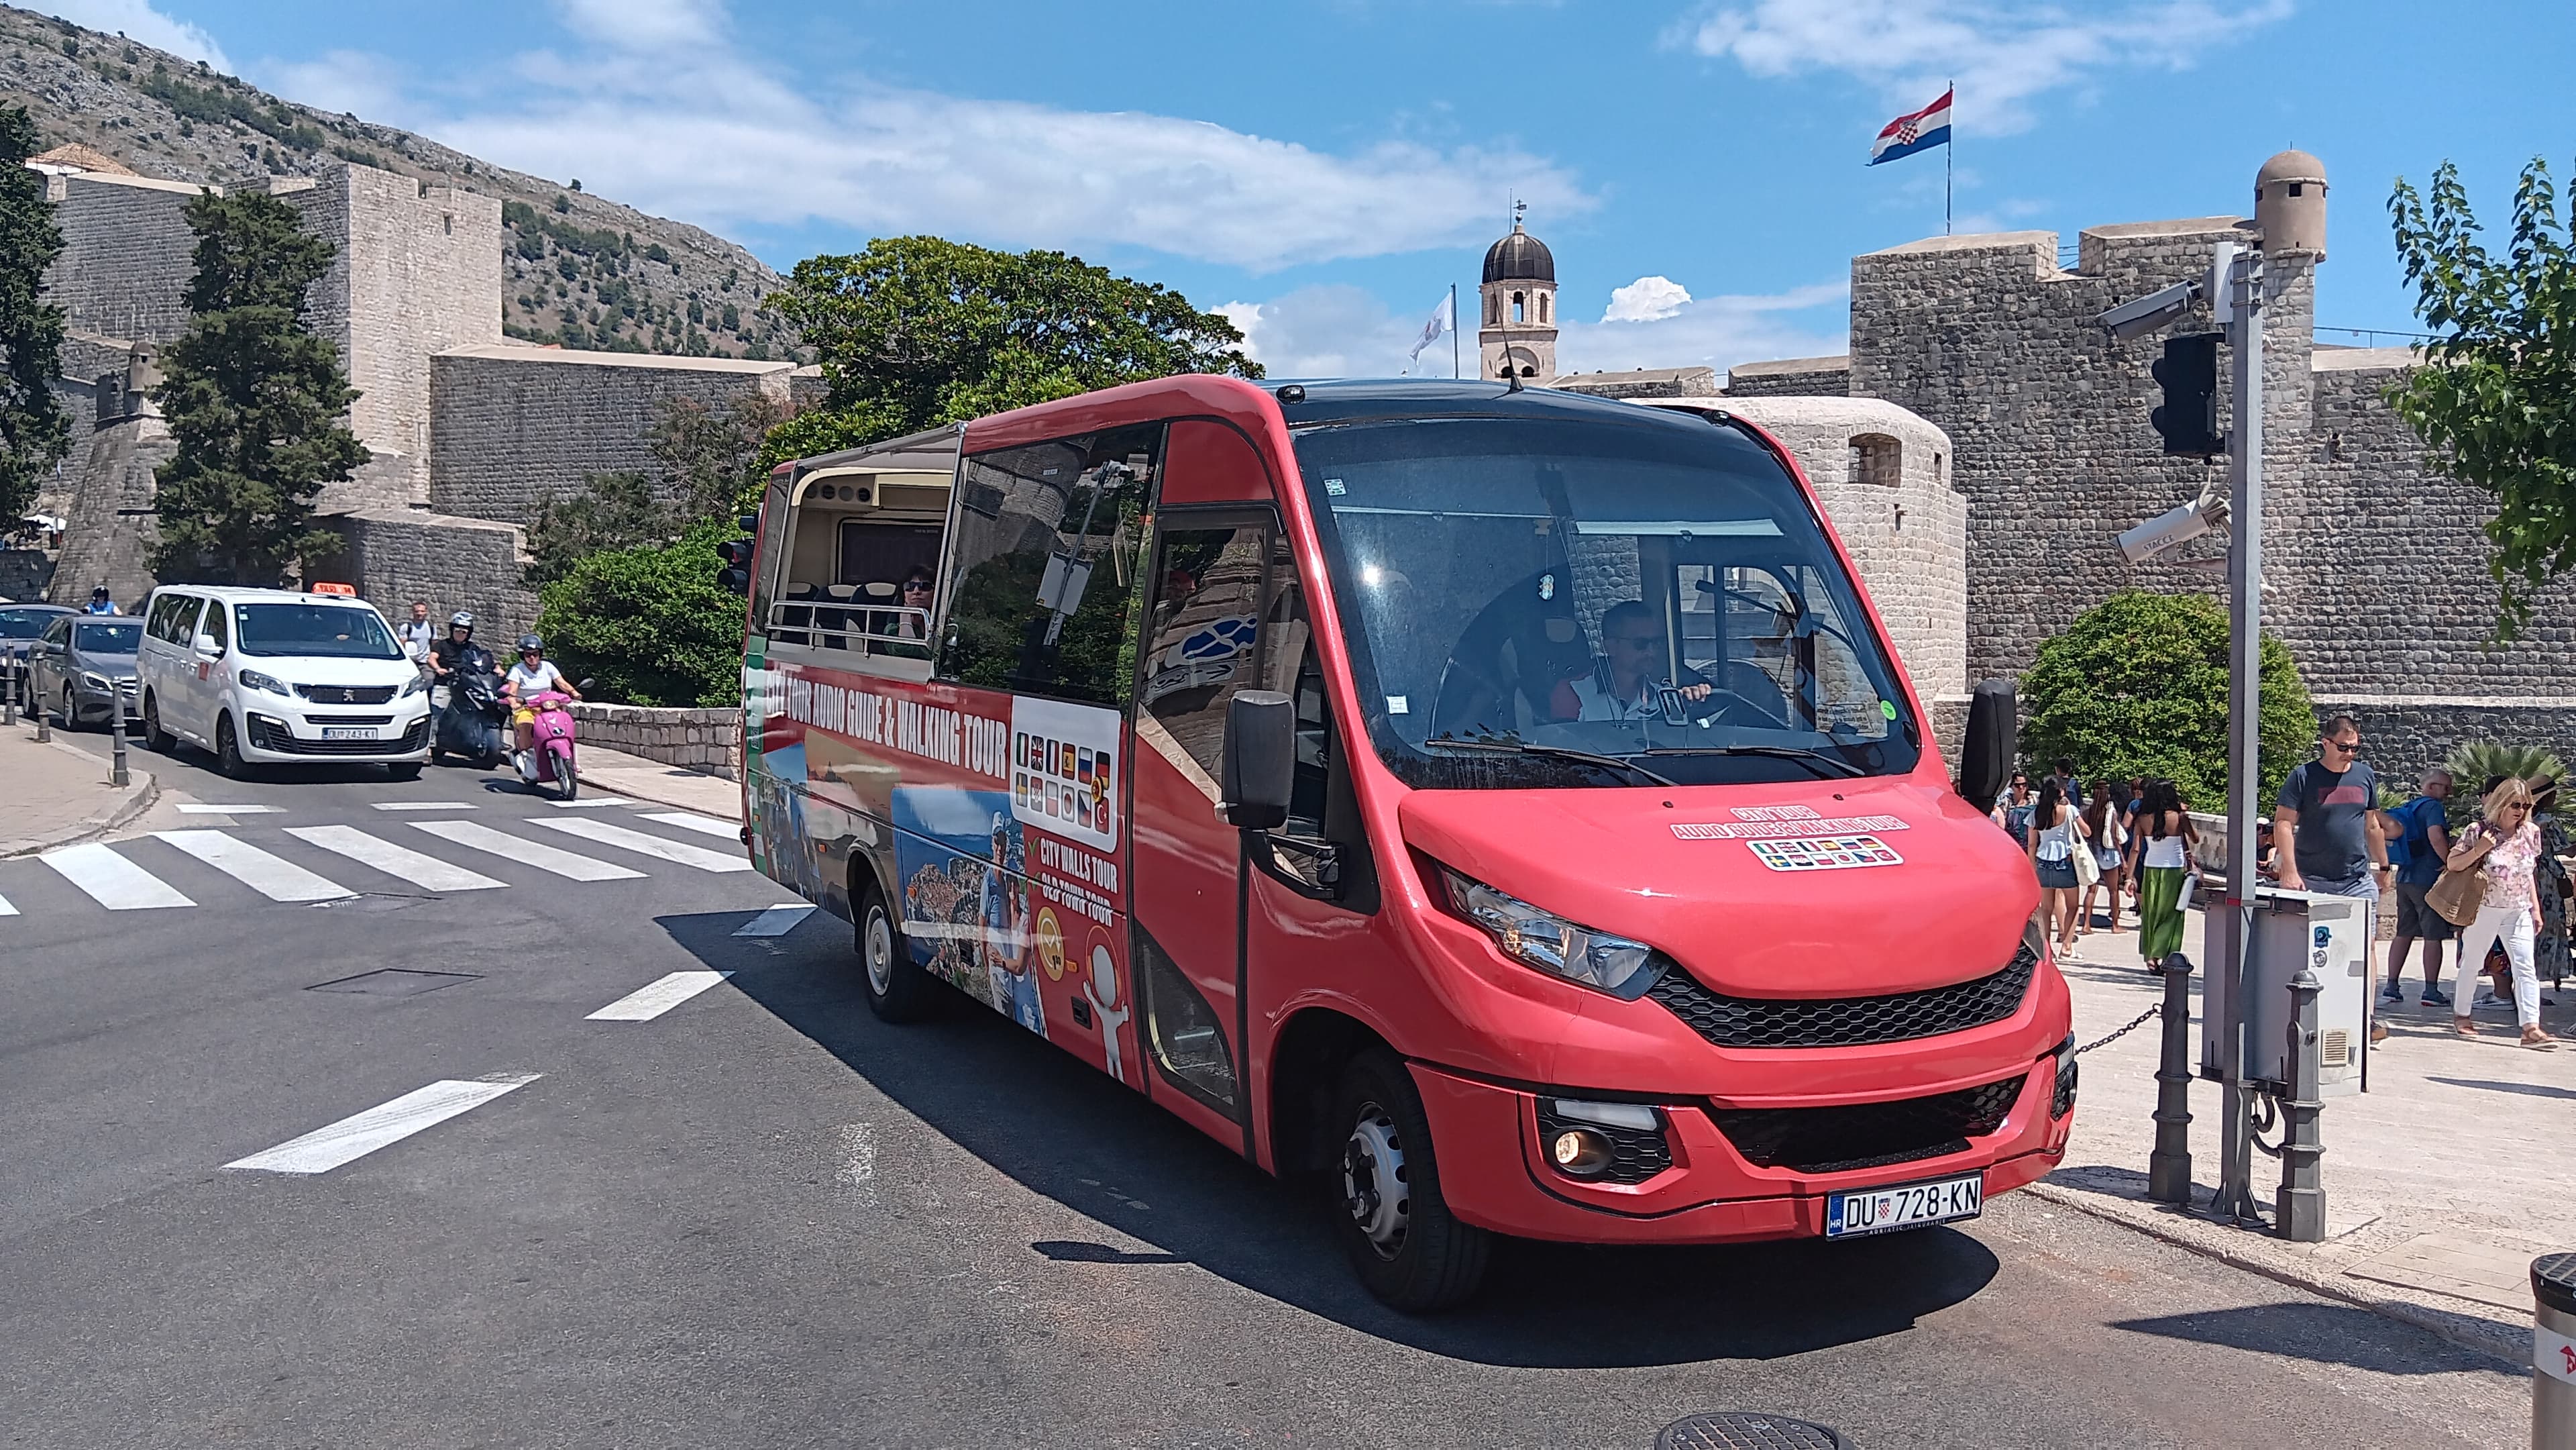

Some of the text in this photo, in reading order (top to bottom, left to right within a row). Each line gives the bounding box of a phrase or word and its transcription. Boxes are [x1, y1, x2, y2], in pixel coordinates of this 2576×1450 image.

[766, 673, 1007, 780] CITY TOUR AUDIO GUIDE & WALKING TOUR
[1670, 823, 1735, 839] AUDIO
[1724, 822, 1787, 838] GUIDE
[1790, 817, 1870, 835] WALKING
[1858, 815, 1910, 831] TOUR
[1766, 806, 1821, 821] TOUR
[1040, 837, 1118, 894] CITY WALLS TOUR
[1042, 872, 1114, 927] OLD TOWN TOUR
[1829, 1219, 1841, 1229] HR
[1846, 1180, 1978, 1229] DU 728-KN
